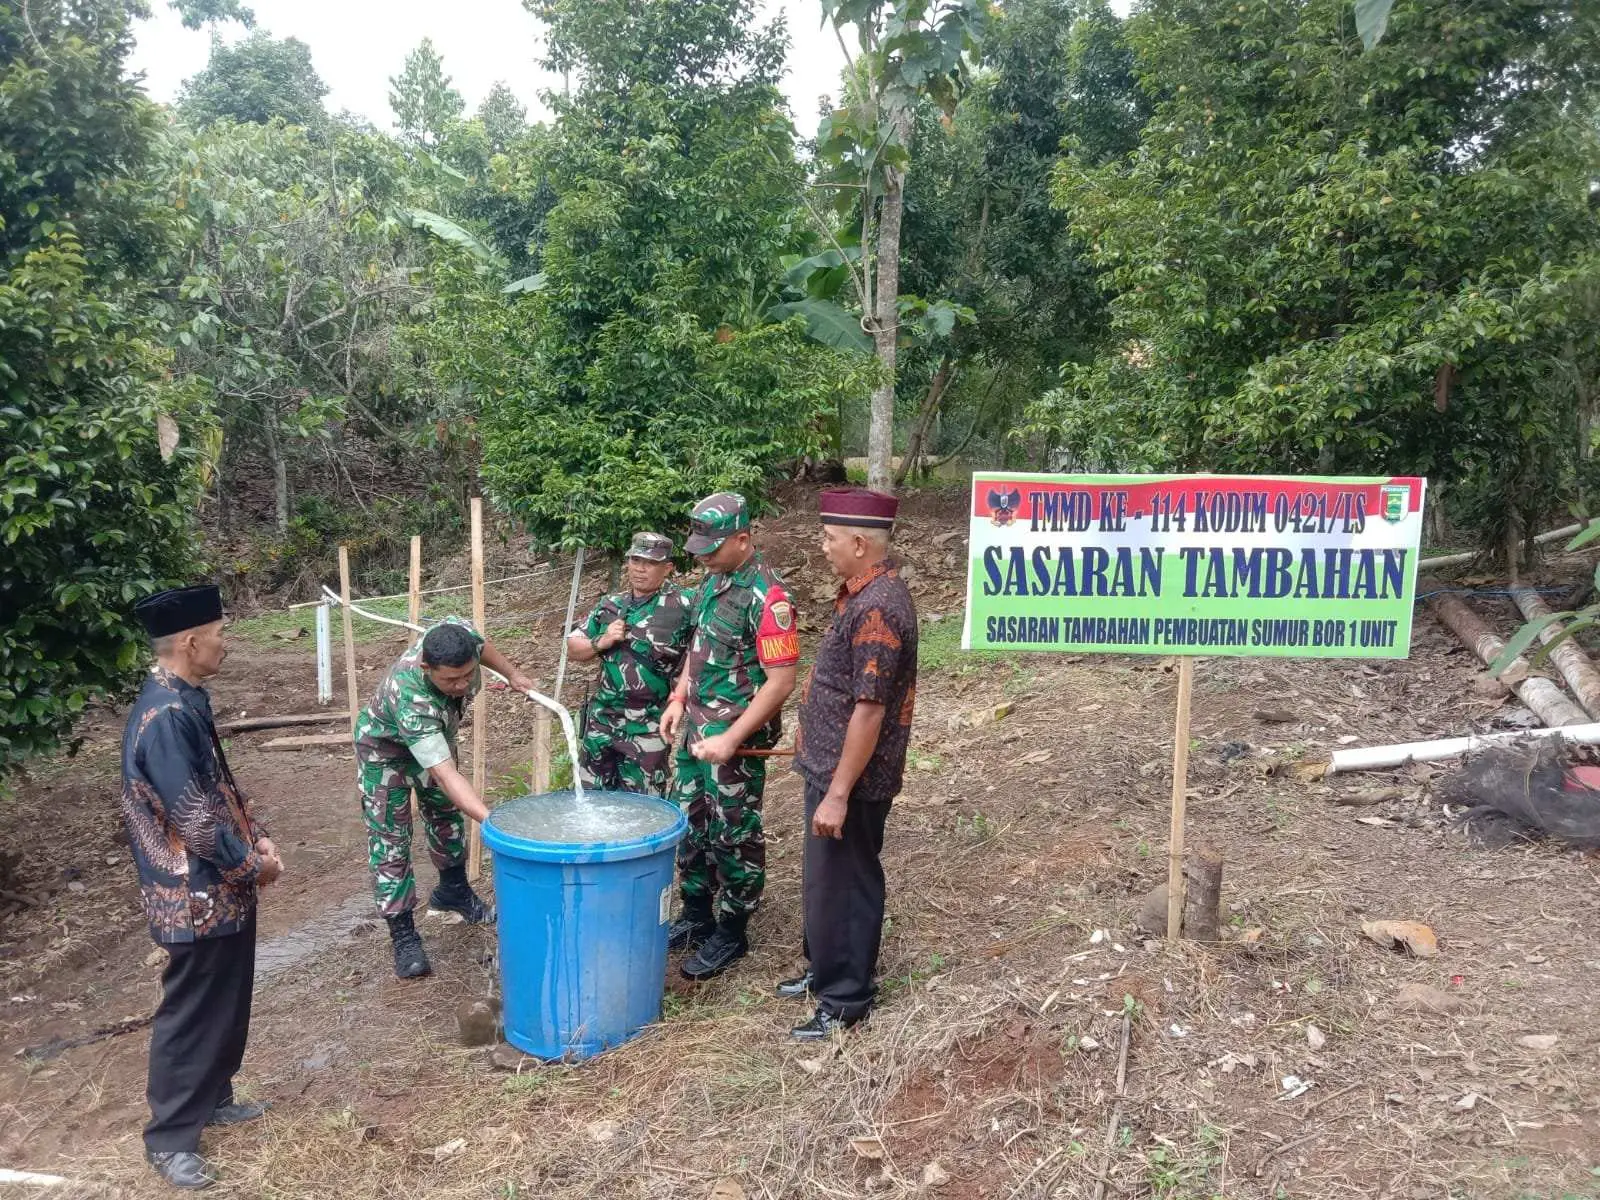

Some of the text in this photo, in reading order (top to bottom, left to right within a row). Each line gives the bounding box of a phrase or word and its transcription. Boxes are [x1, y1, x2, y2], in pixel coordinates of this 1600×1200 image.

[1029, 491, 1092, 532] TMMD
[1098, 491, 1127, 532] KE
[1150, 491, 1186, 532] 114
[1193, 491, 1268, 533] KODIM
[1274, 491, 1366, 534] 0421/LS
[983, 545, 1407, 599] SASARAN TAMBAHAN
[986, 616, 1398, 648] SASARAN TAMBAHAN PEMBUATAN SUMUR BOR 1 UNIT
